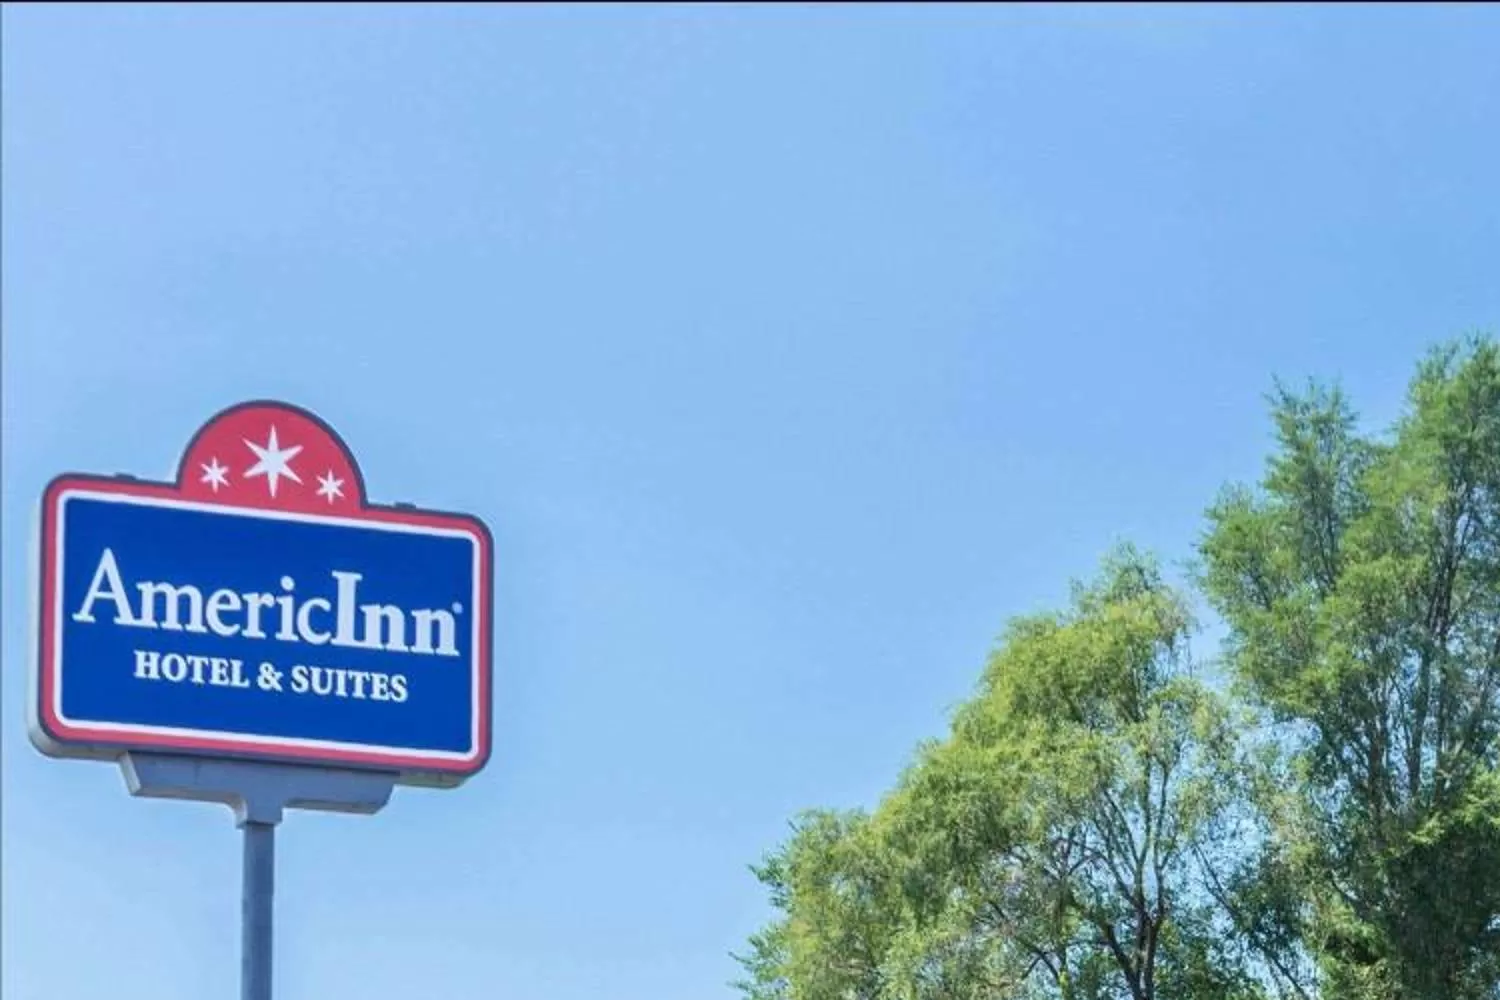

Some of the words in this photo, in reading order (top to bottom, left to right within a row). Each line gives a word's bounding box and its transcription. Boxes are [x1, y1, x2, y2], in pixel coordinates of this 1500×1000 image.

[72, 548, 460, 656] AmericInn
[134, 650, 250, 688] HOTEL
[257, 662, 283, 691] &
[291, 665, 409, 703] SUITES
